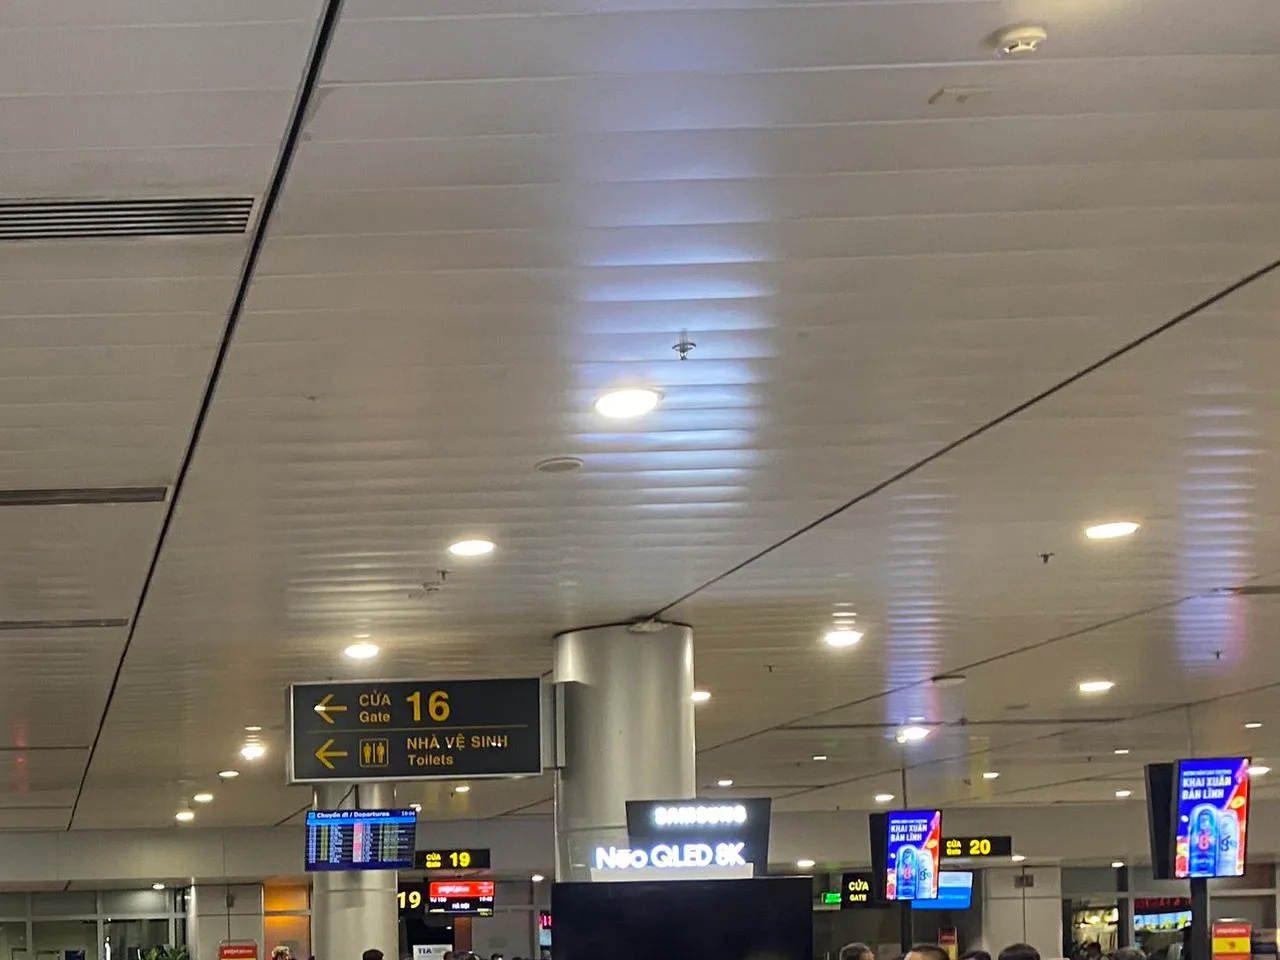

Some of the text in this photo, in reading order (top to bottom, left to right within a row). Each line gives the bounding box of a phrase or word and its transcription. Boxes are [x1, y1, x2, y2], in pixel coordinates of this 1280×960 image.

[358, 690, 450, 722] CỬA 16
[359, 711, 390, 724] Gate
[407, 733, 508, 751] NHÀ VỆ SINH
[408, 754, 454, 766] Toilets
[969, 839, 991, 855] 20
[450, 852, 470, 867] 19
[650, 844, 713, 868] QLED
[716, 842, 746, 866] 8K
[848, 879, 869, 891] CỬA
[397, 891, 421, 908] 19
[850, 894, 867, 902] GATE
